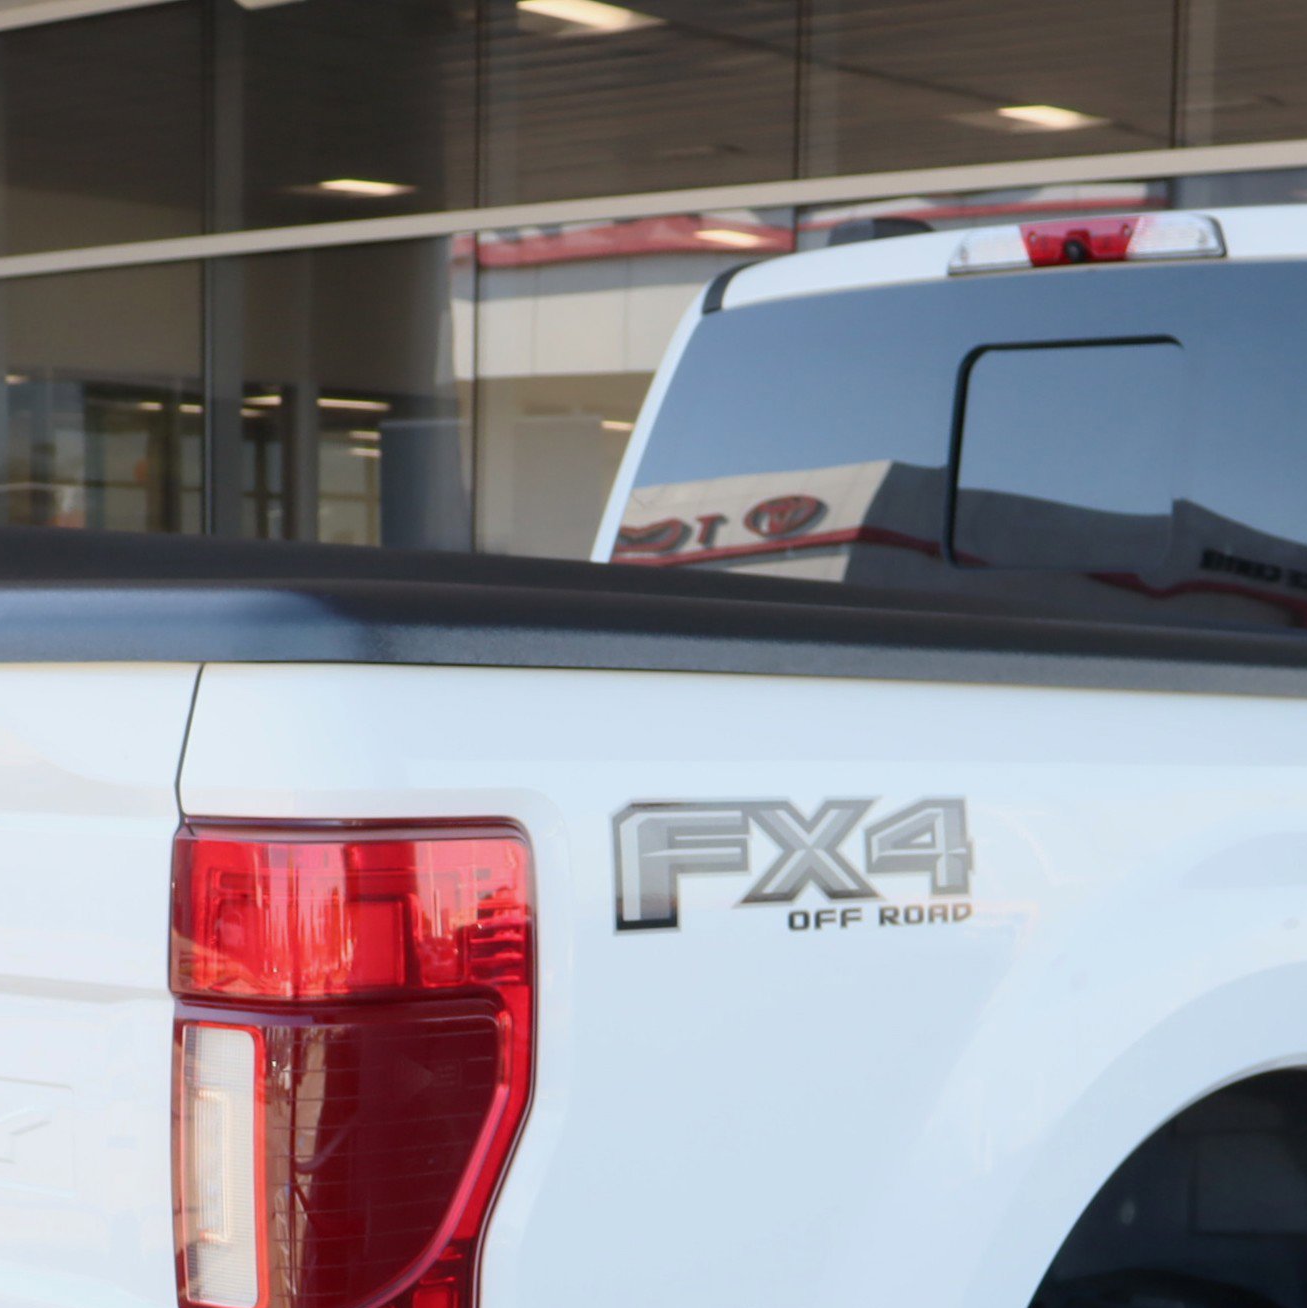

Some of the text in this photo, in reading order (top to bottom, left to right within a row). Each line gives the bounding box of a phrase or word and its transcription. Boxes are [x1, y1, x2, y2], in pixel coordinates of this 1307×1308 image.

[611, 796, 972, 932] FX4
[788, 903, 973, 932] OFF ROAD
